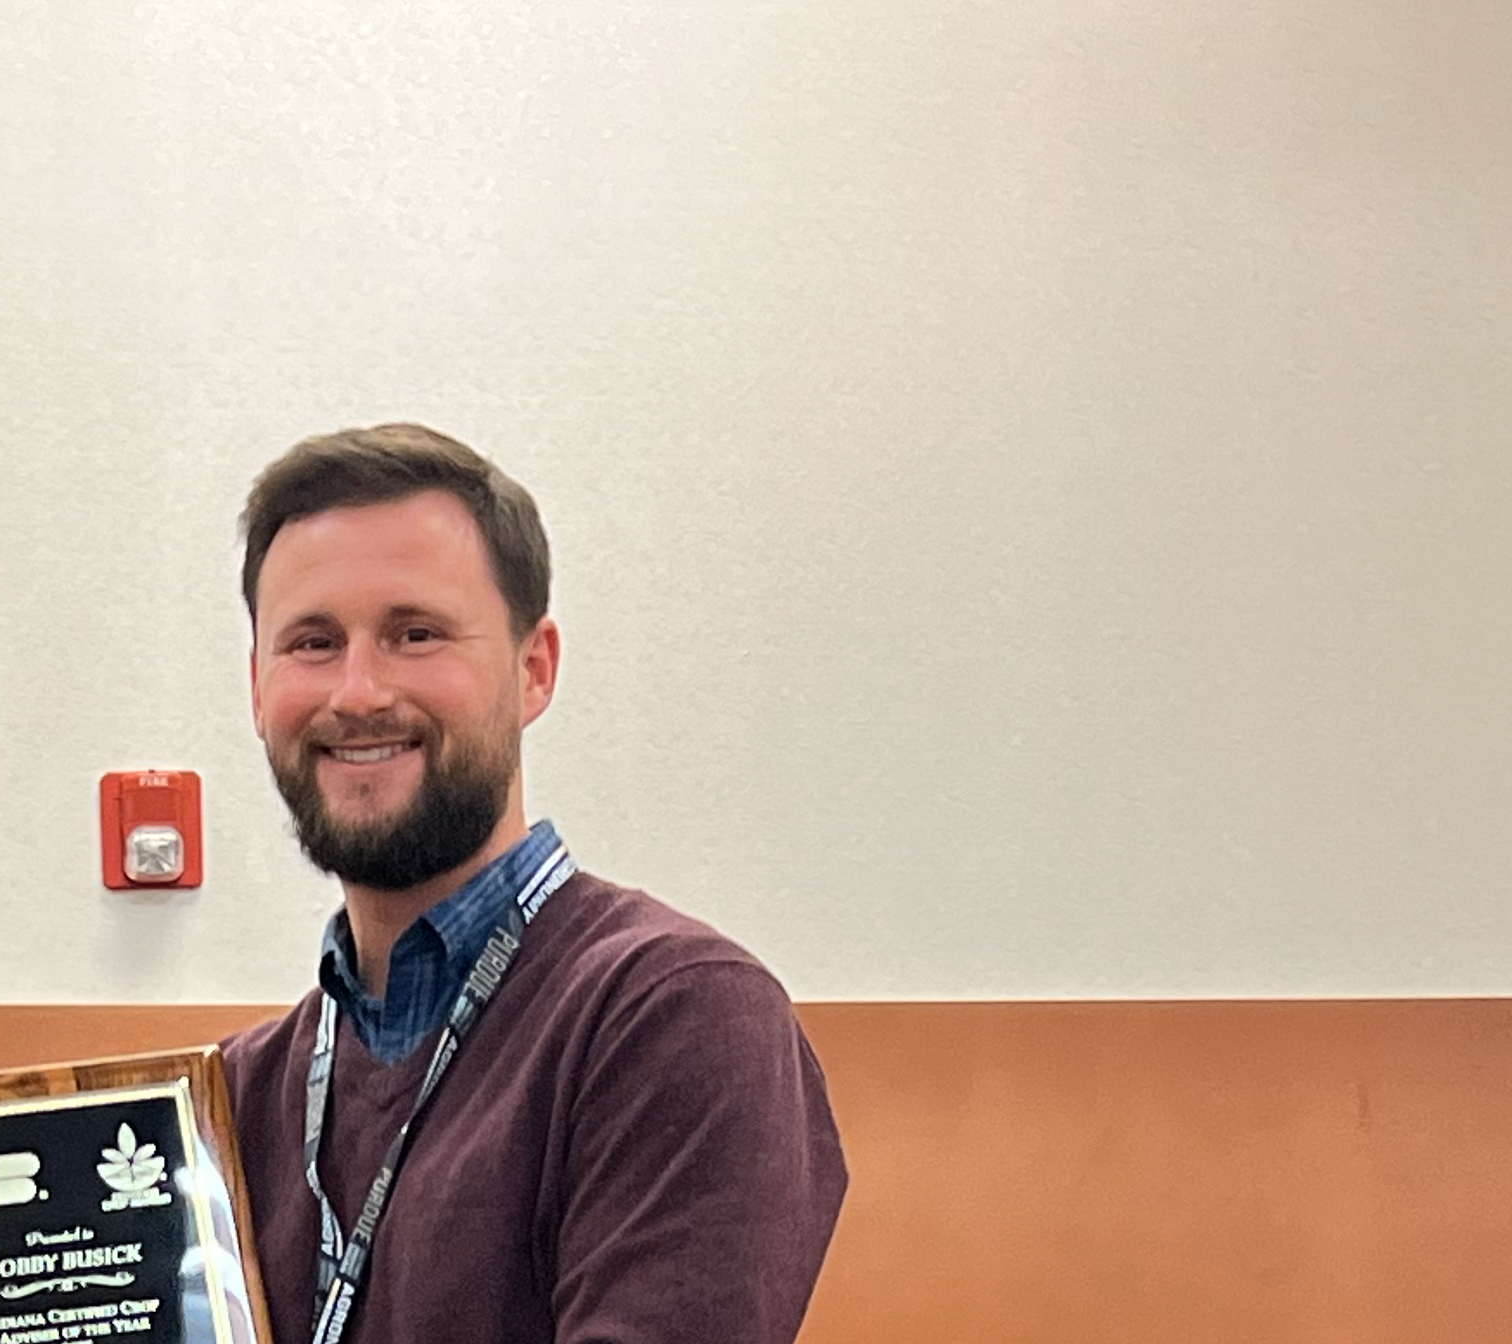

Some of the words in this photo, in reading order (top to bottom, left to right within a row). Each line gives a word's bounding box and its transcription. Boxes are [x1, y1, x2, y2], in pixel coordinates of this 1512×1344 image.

[462, 926, 520, 1001] PURDUE
[353, 1166, 393, 1244] PURDUE
[61, 1243, 143, 1270] BUSICK
[113, 1317, 152, 1334] YEAR
